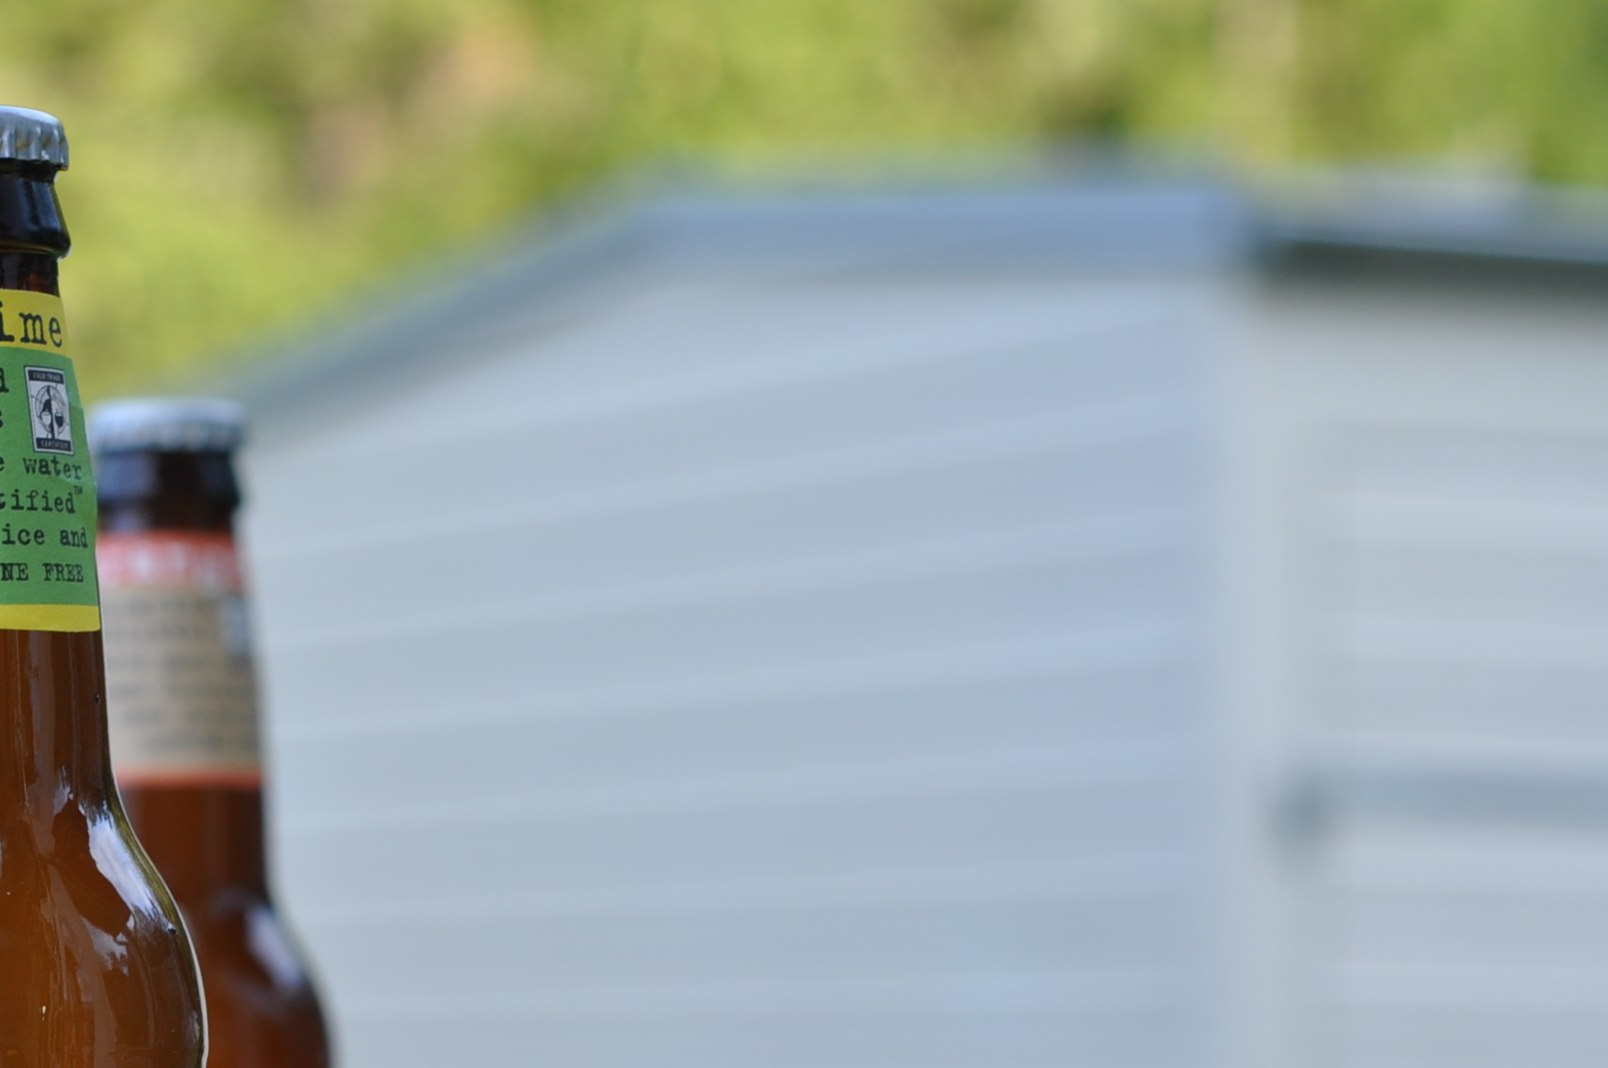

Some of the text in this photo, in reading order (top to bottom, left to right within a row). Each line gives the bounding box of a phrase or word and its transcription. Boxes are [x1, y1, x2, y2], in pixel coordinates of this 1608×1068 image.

[23, 456, 83, 480] water
[59, 527, 88, 549] and
[43, 562, 85, 583] FREE
